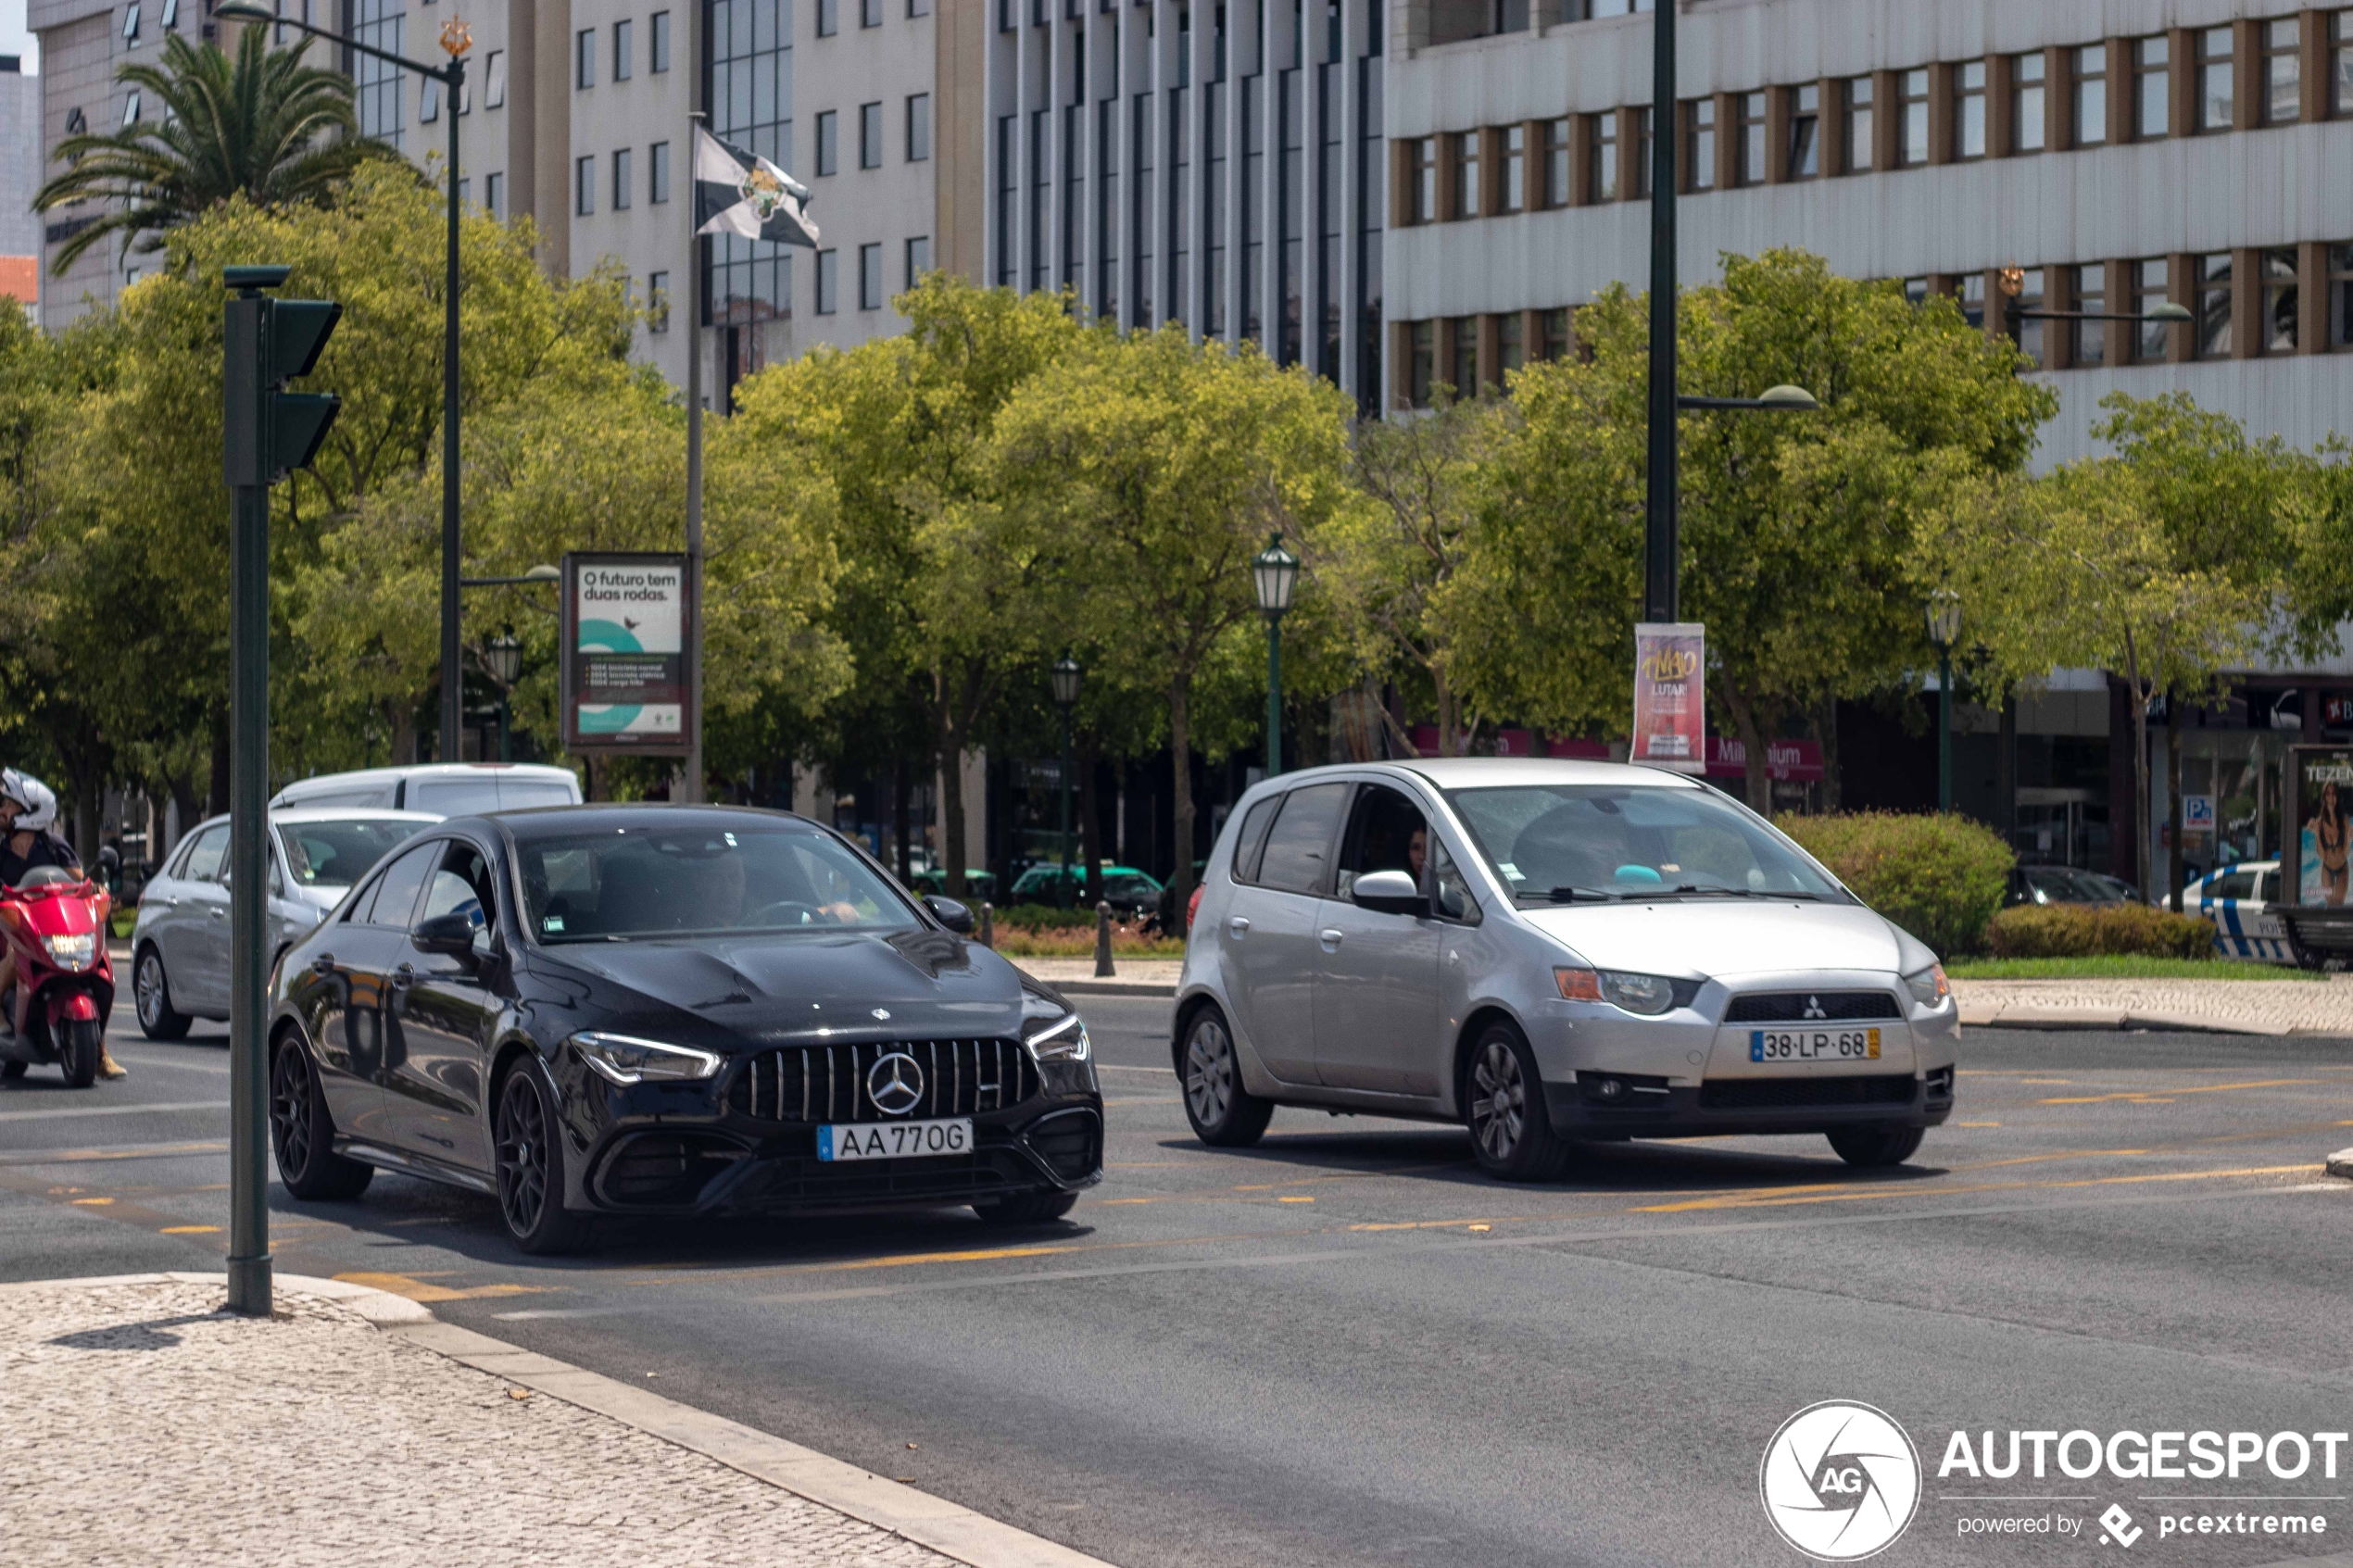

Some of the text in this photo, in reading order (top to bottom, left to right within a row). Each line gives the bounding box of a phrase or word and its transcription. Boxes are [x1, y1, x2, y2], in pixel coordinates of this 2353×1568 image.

[584, 571, 676, 586] O futuro tem
[584, 586, 668, 601] duas rodas.
